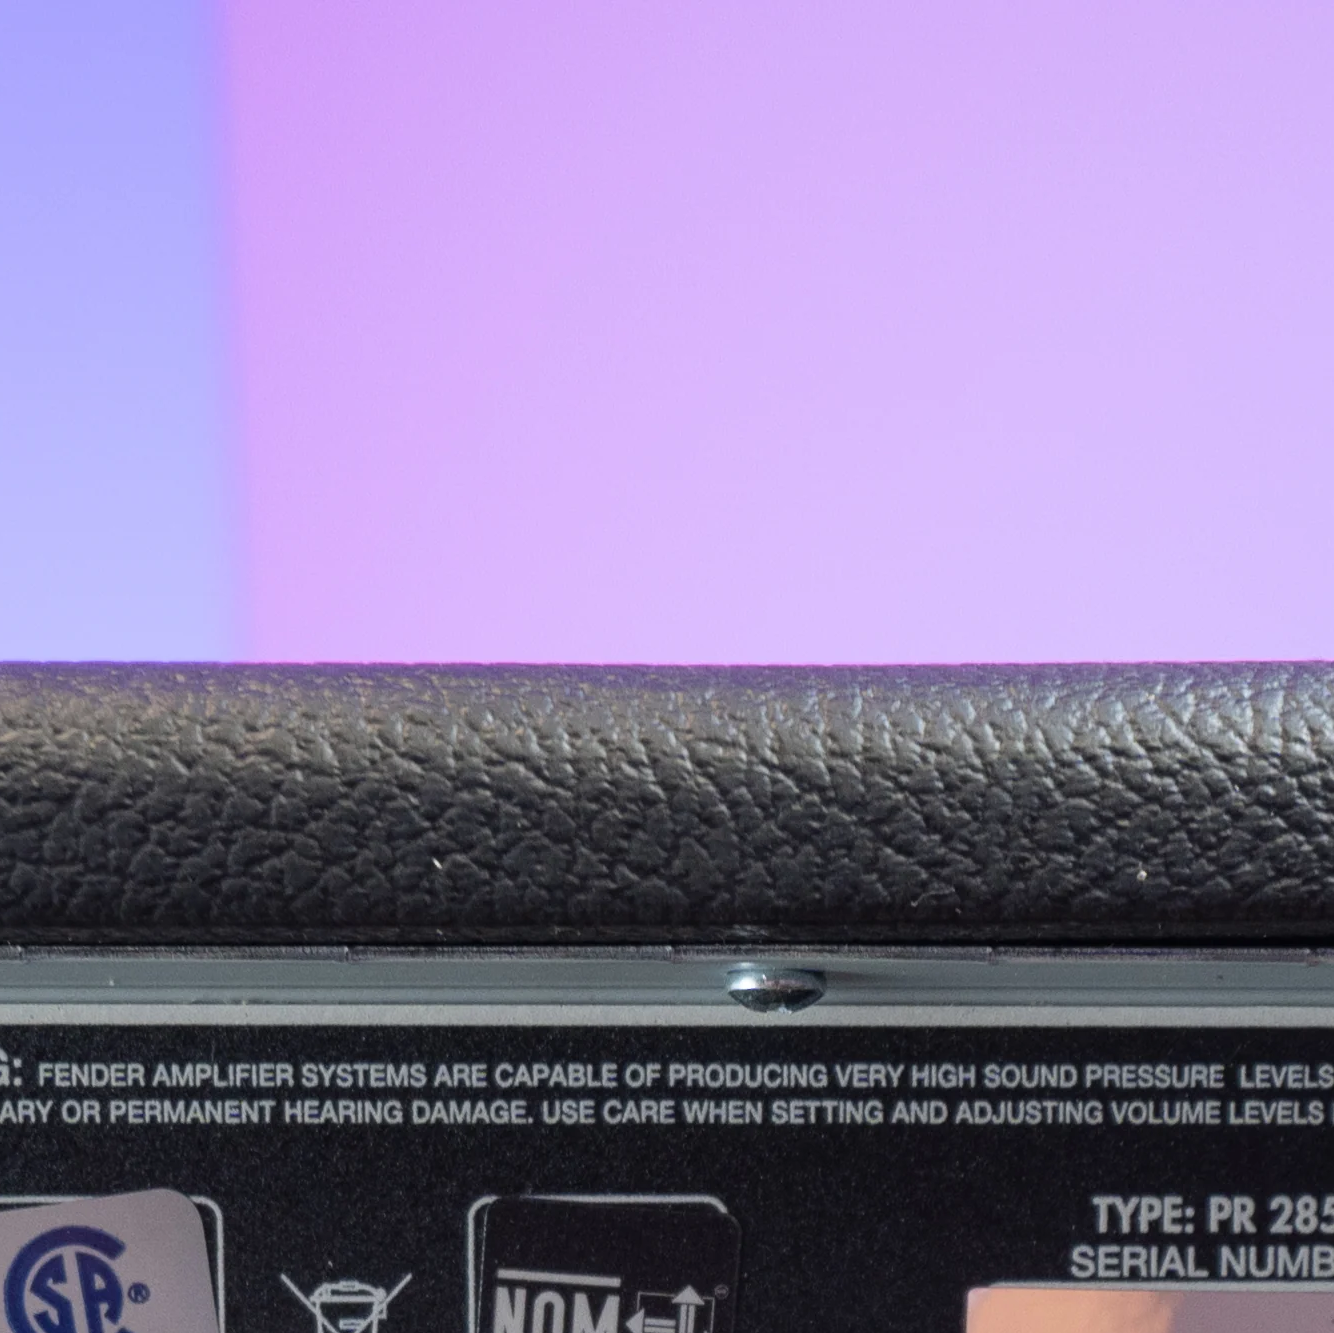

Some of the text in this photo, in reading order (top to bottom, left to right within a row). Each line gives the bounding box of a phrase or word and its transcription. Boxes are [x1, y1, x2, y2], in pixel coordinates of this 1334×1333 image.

[37, 1062, 146, 1089] FENDER
[152, 1062, 295, 1089] AMPLIFIER
[301, 1062, 427, 1089] SYSTEMS
[434, 1062, 488, 1089] ARE
[494, 1062, 618, 1089] CAPABLE
[624, 1062, 662, 1089] OF
[668, 1062, 828, 1089] PRODUCING
[834, 1062, 905, 1089] VERY
[910, 1062, 977, 1089] HIGH
[983, 1062, 1079, 1089] SOUND
[1085, 1063, 1225, 1089] PRESSURE
[61, 1098, 102, 1125] OR
[108, 1098, 277, 1126] PERMANENT
[284, 1098, 404, 1125] HEARING
[411, 1098, 534, 1126] DAMAGE.
[541, 1098, 596, 1126] USE
[602, 1098, 676, 1125] CARE
[682, 1099, 764, 1125] WHEN
[771, 1098, 884, 1126] SETTING
[890, 1099, 949, 1125] AND
[955, 1099, 1104, 1126] ADJUSTING
[1110, 1099, 1222, 1126] VOLUME
[1228, 1099, 1325, 1126] LEVELS
[1091, 1194, 1195, 1235] TYPE:
[1208, 1194, 1257, 1234] PR
[1069, 1243, 1209, 1279] SERIAL
